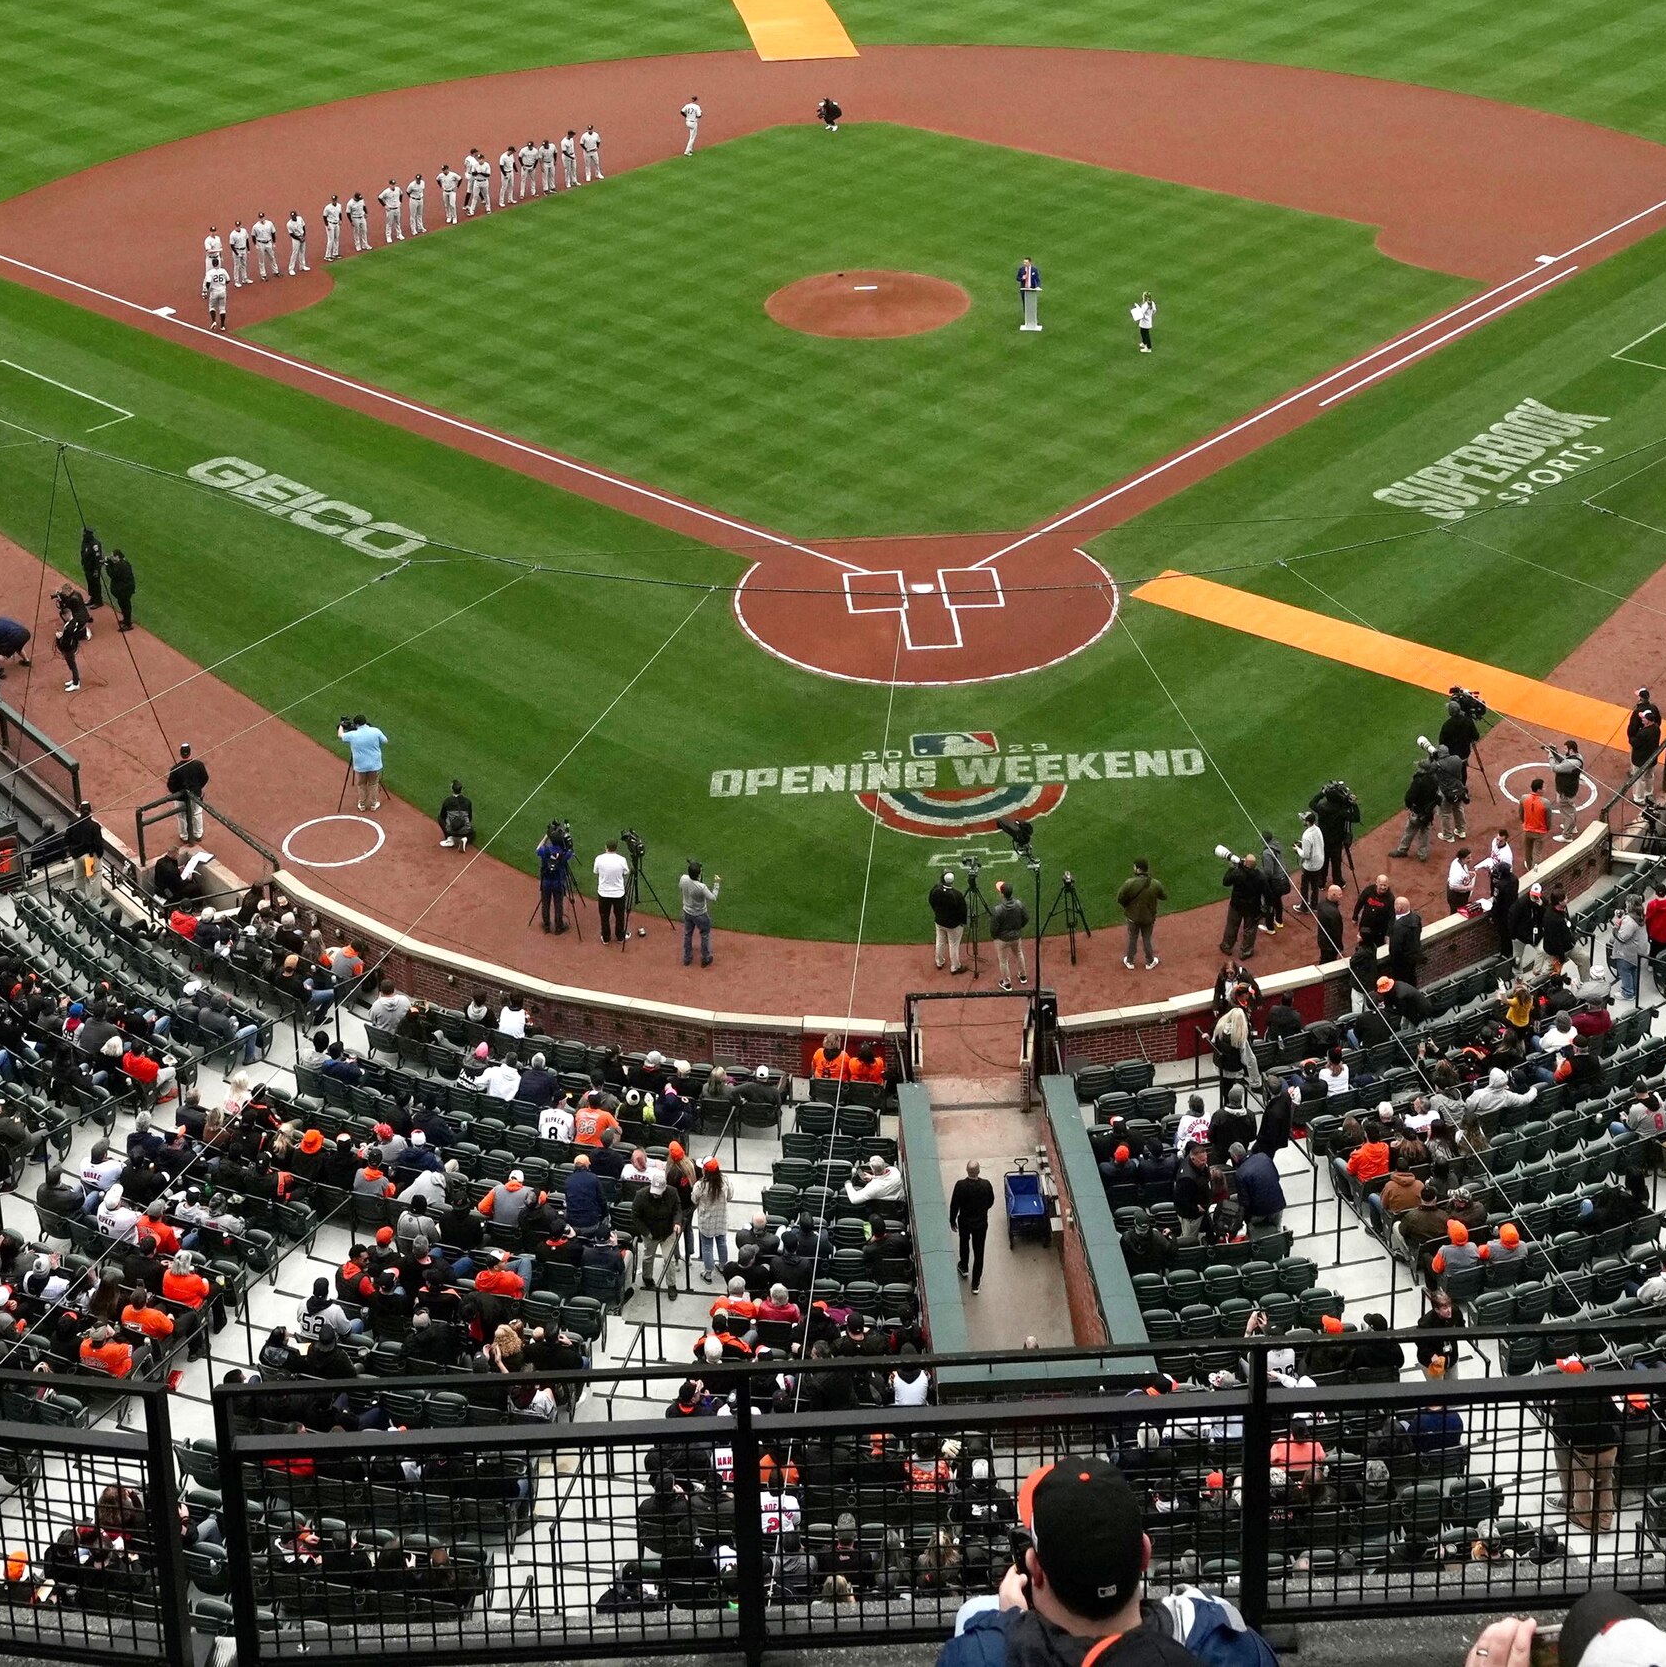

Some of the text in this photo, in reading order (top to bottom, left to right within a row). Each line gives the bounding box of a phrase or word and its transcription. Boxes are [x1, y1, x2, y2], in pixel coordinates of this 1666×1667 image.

[213, 274, 224, 283] 26
[1373, 397, 1611, 520] SUPERBOOK
[1497, 442, 1604, 505] SPORTS
[186, 456, 428, 559] GEICO
[861, 742, 1049, 760] 20 23
[708, 747, 1207, 798] OPENING WEEKEND
[545, 1116, 564, 1125] RIPKEN
[549, 1126, 558, 1140] 8
[98, 1214, 116, 1227] RIPKEN
[303, 1312, 324, 1332] 52
